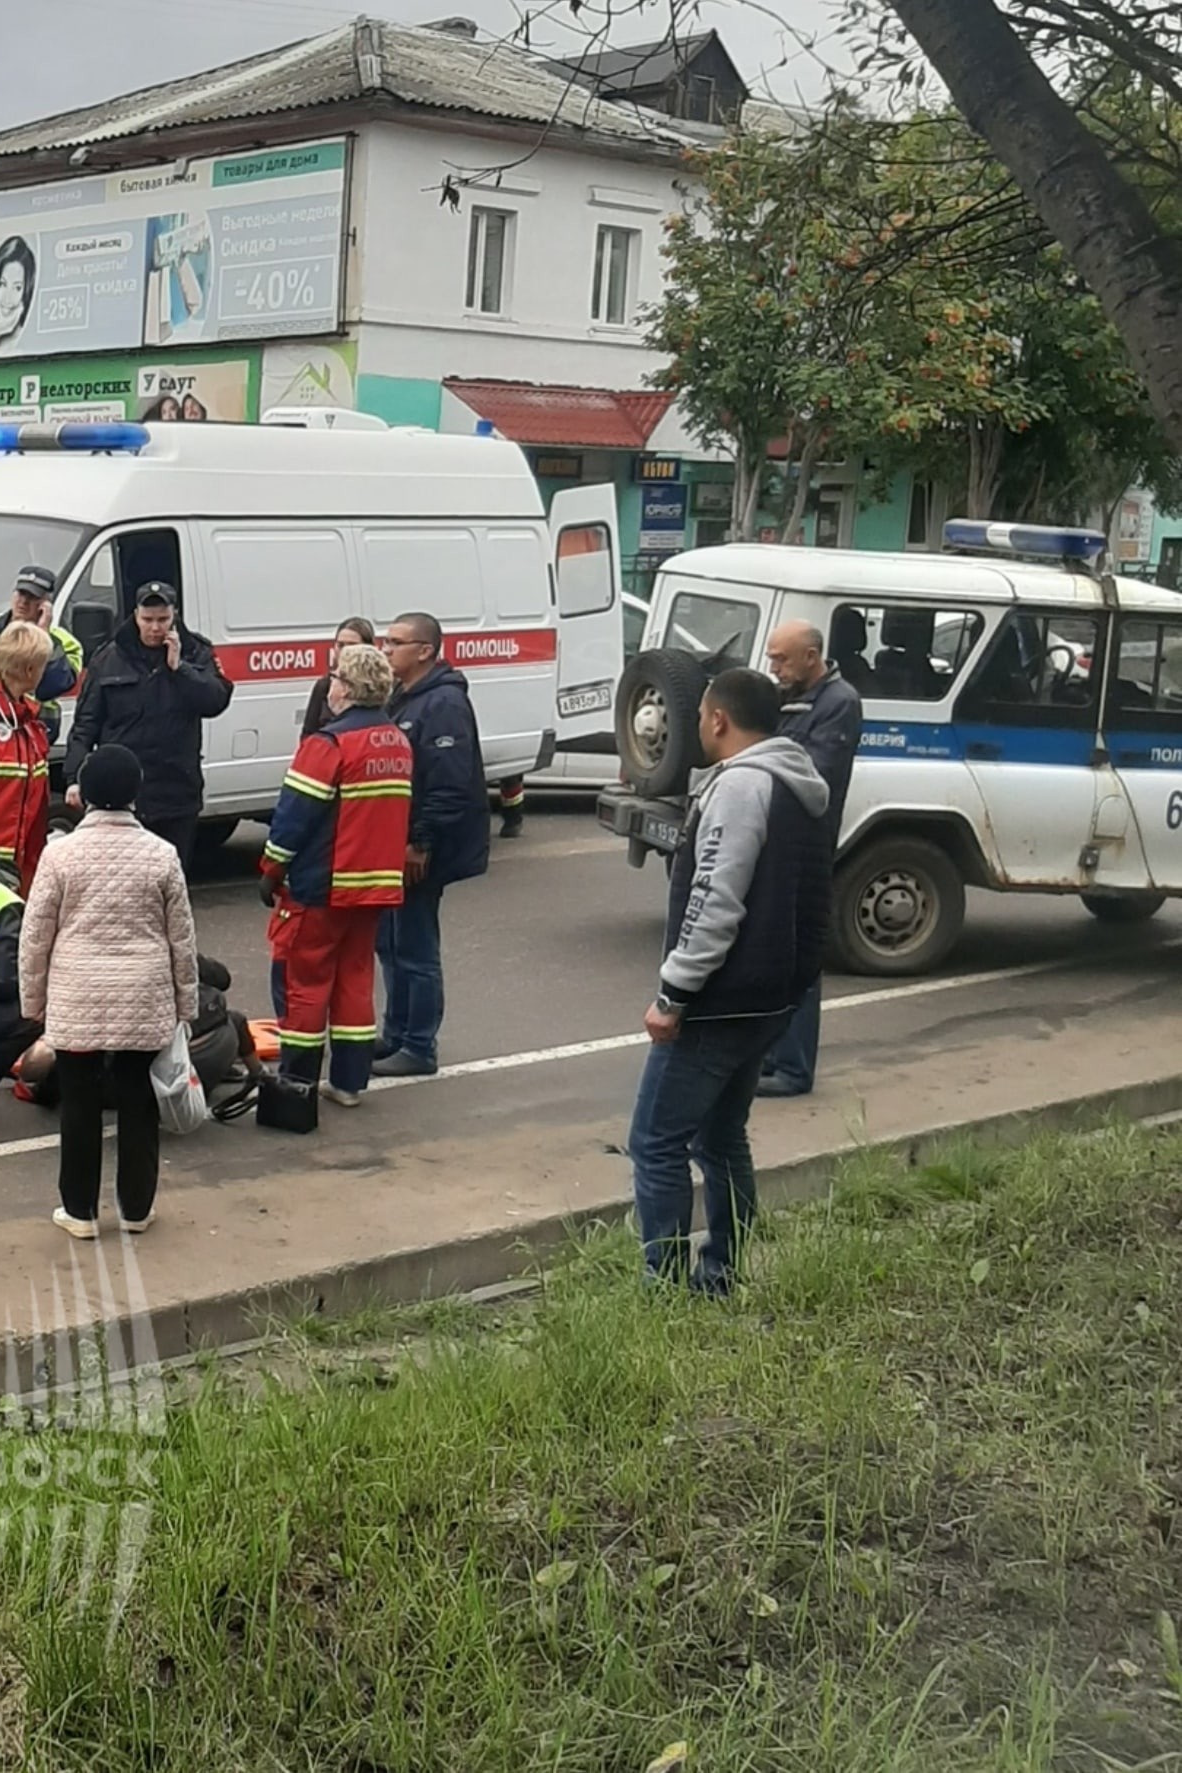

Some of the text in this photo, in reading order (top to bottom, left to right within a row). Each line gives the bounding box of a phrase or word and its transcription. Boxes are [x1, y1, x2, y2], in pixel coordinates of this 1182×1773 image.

[223, 162, 264, 178] товары
[289, 153, 319, 170] дома
[143, 373, 197, 394] Услуг
[455, 638, 520, 659] ПОМОЩЬ
[249, 648, 315, 673] СКОРАЯ
[858, 732, 906, 748] ОВЕРИЯ
